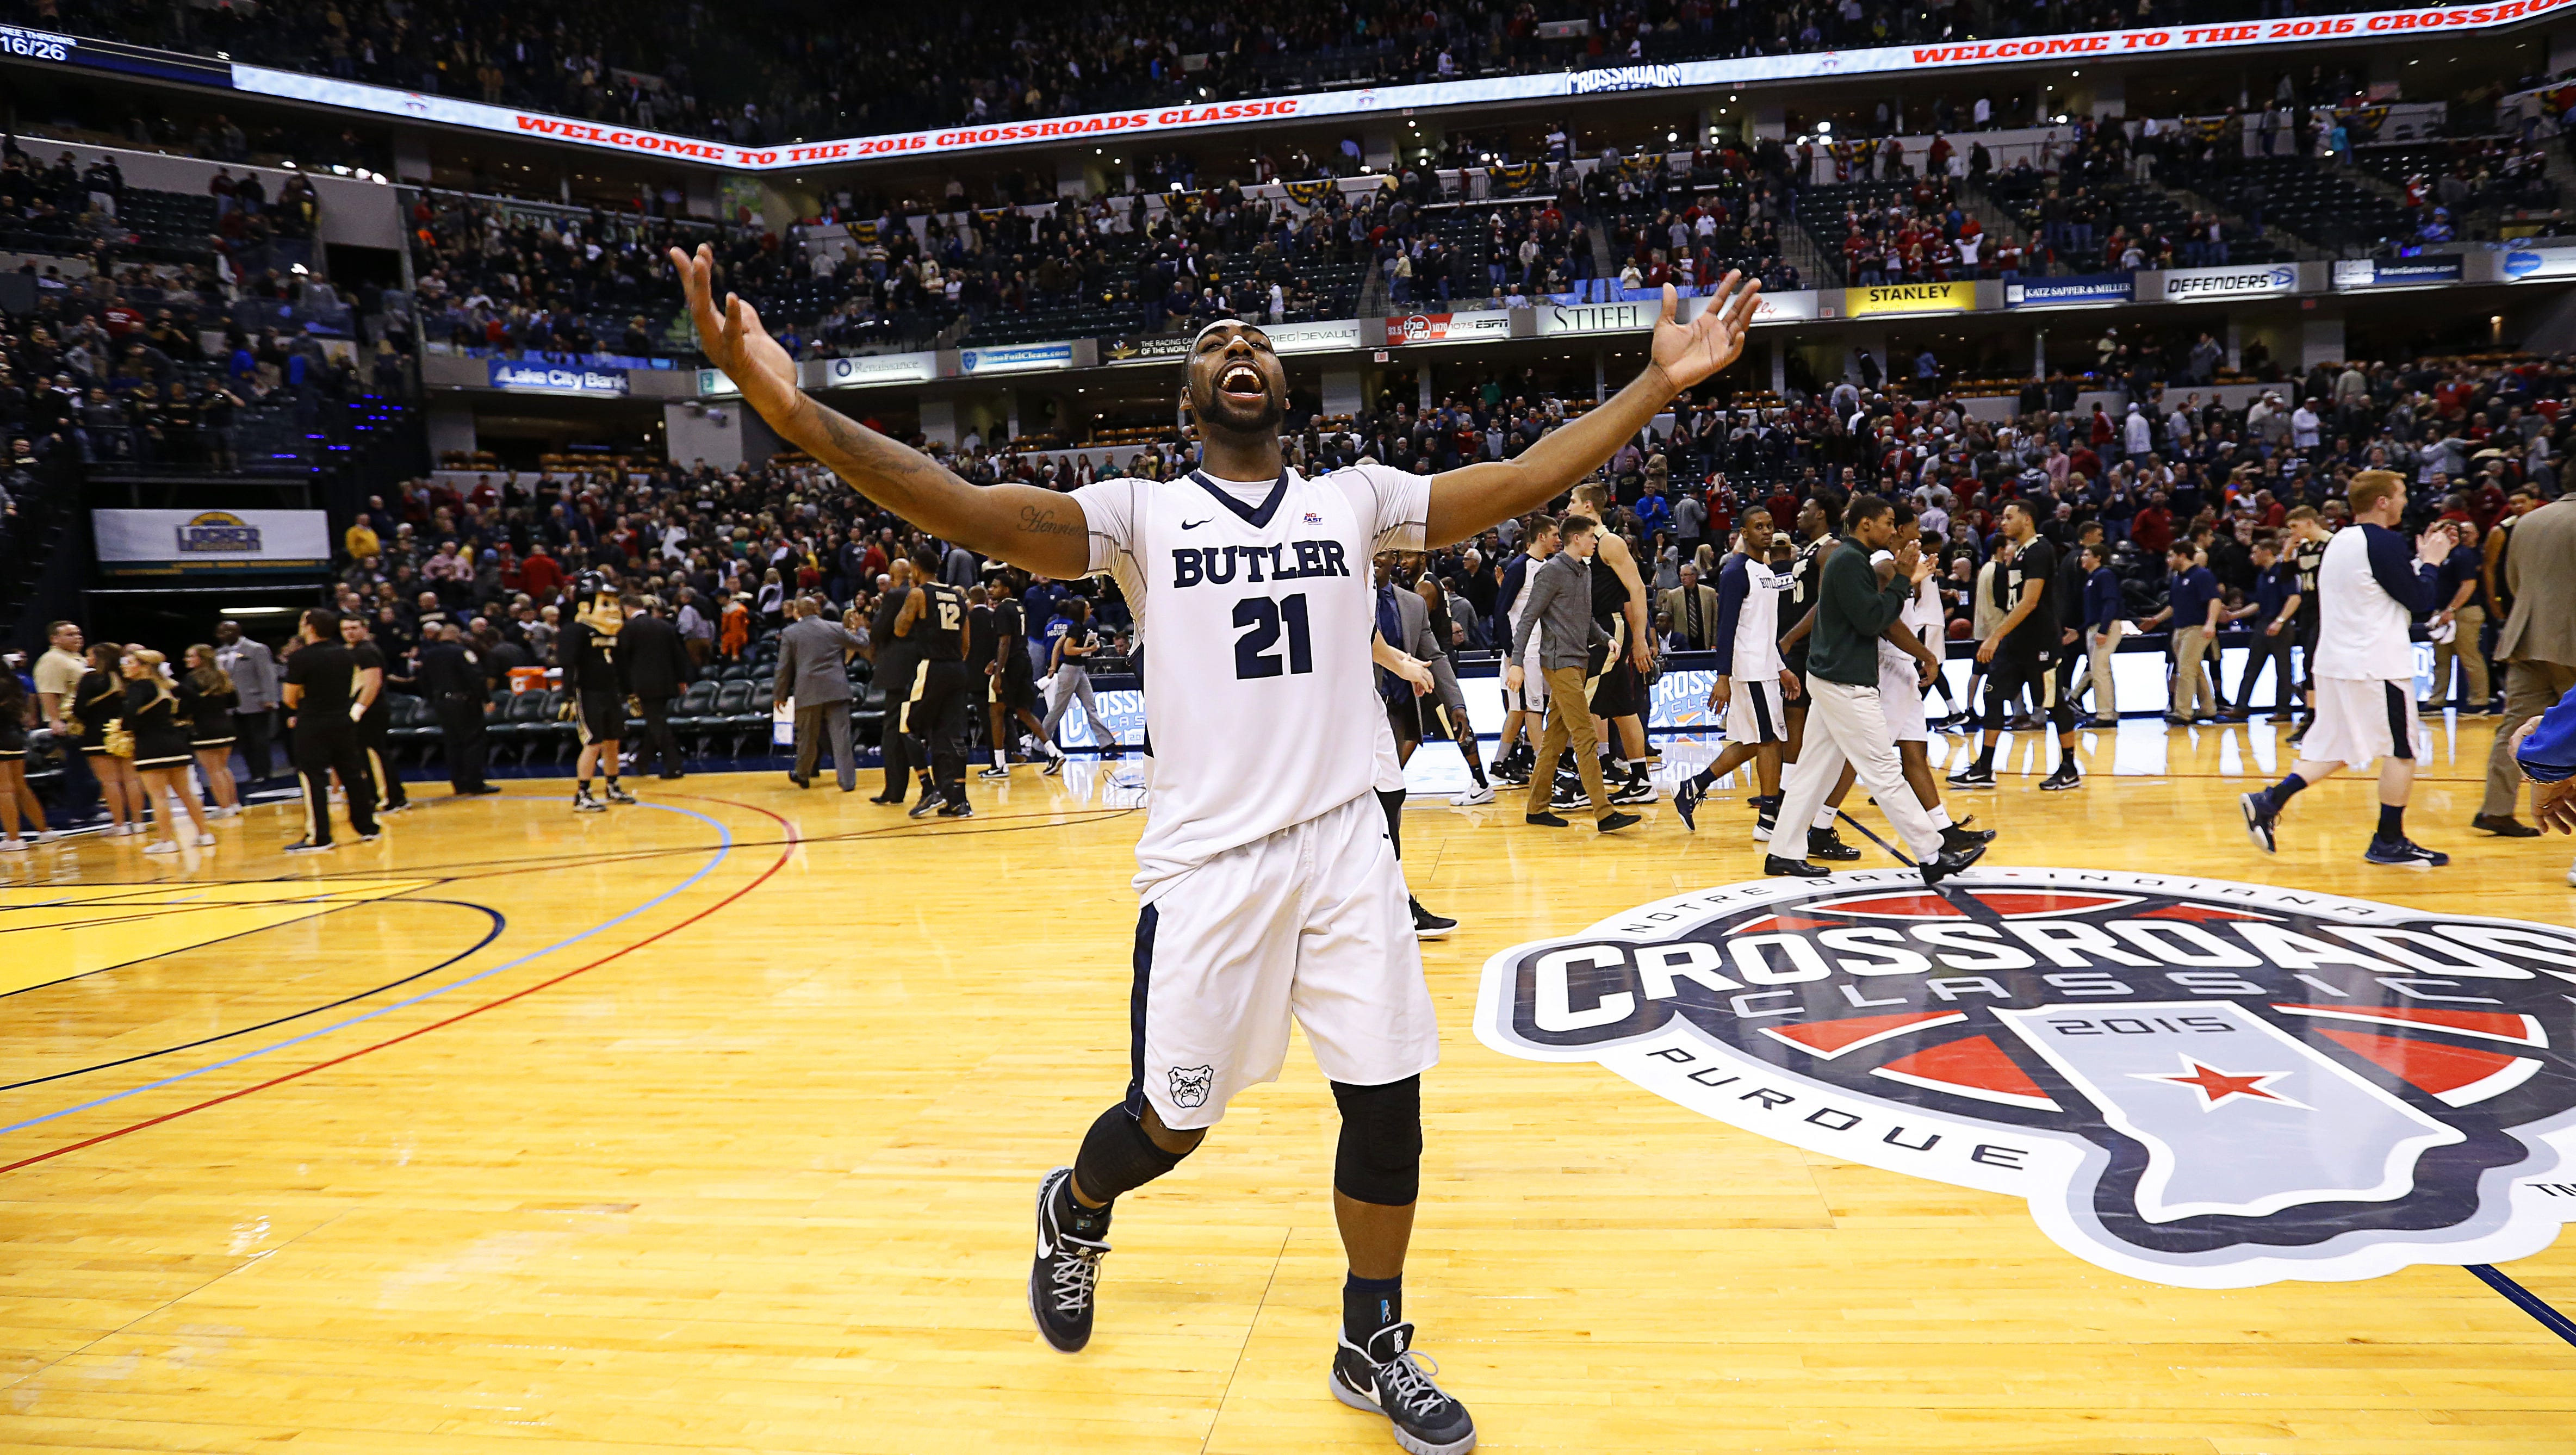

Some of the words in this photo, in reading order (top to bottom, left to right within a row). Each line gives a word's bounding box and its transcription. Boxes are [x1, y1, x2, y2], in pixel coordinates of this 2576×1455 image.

[1913, 36, 2109, 63] WELCOME
[2122, 33, 2169, 48] TO
[2183, 26, 2260, 43] THE
[2269, 19, 2355, 38] 2015
[2367, 0, 2572, 30] CROSSRO
[0, 35, 67, 61] 16/26
[516, 115, 724, 159] WELCOME
[736, 151, 777, 164] TO
[789, 144, 849, 161] THE
[858, 136, 926, 154] 2015
[936, 114, 1149, 146] CROSSROADS
[1158, 100, 1298, 124] CLASSIC
[1870, 285, 1951, 302] STANLEY
[2025, 287, 2050, 298] KATZ
[2095, 283, 2131, 294] MILLER
[2168, 275, 2269, 293] DEFENDERS
[1268, 333, 1295, 342] RIEG
[1300, 329, 1358, 341] DEVAULT
[1404, 319, 1425, 330] the
[1409, 329, 1431, 340] fan
[1475, 319, 1509, 329] ESPN
[1141, 347, 1151, 356] OF
[1156, 338, 1181, 346] RACING
[495, 366, 546, 384] Lake
[548, 370, 584, 390] City
[585, 372, 629, 390] Bank
[1172, 539, 1350, 588] BUTLER
[937, 602, 960, 630] 12
[1232, 593, 1313, 680] 21
[1620, 887, 1773, 933] NOTRE
[2048, 873, 2378, 915] INDIANA
[1535, 919, 2576, 1032] CROSSROADS
[1729, 972, 2504, 1019] CLASSIC
[2047, 1017, 2237, 1035] 2015
[1646, 1047, 2029, 1171] PURDUE
